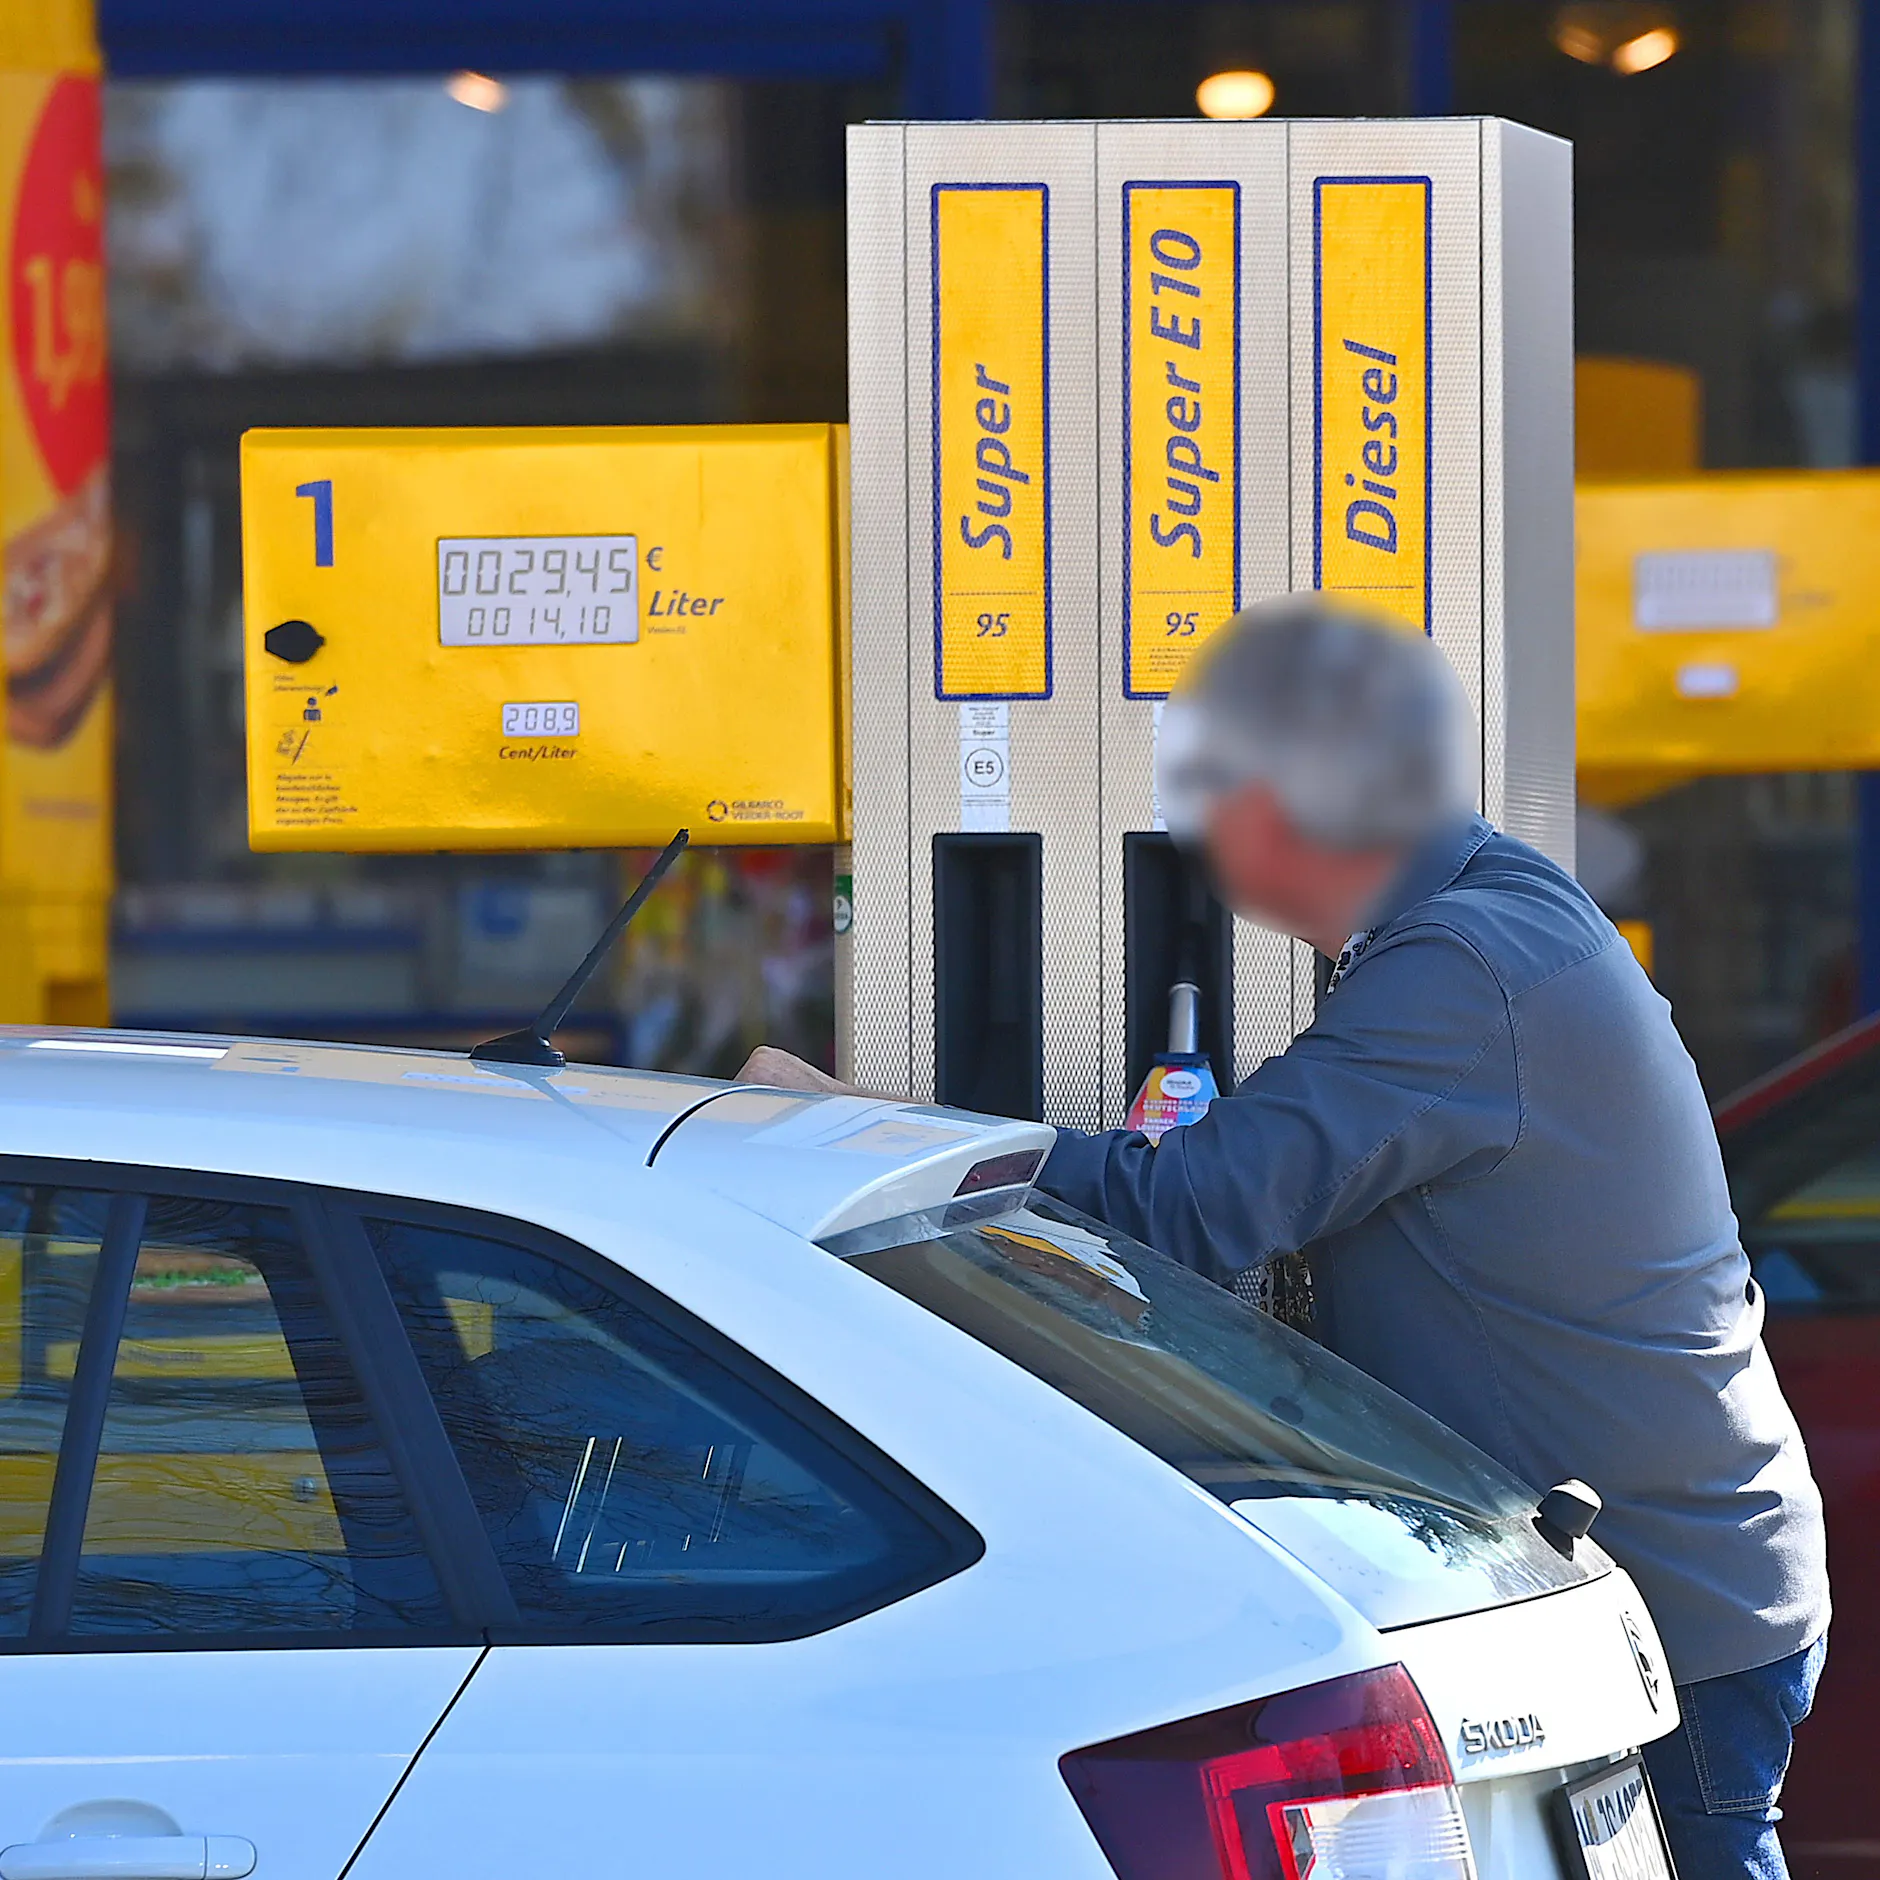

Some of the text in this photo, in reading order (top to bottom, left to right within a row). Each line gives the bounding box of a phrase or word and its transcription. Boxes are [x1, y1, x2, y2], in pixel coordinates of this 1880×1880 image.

[1150, 228, 1219, 558] Super E10
[1343, 338, 1398, 554] Diesel
[960, 363, 1031, 560] Super
[295, 480, 333, 567] 1
[645, 546, 664, 572] €
[442, 549, 632, 598] 0029,45
[648, 590, 725, 617] Liter
[467, 605, 611, 639] 0014,10
[976, 613, 1011, 637] 95
[1165, 612, 1199, 636] 95
[505, 708, 576, 734] 208,9
[498, 745, 578, 762] Cent/Liter
[974, 761, 994, 774] E5
